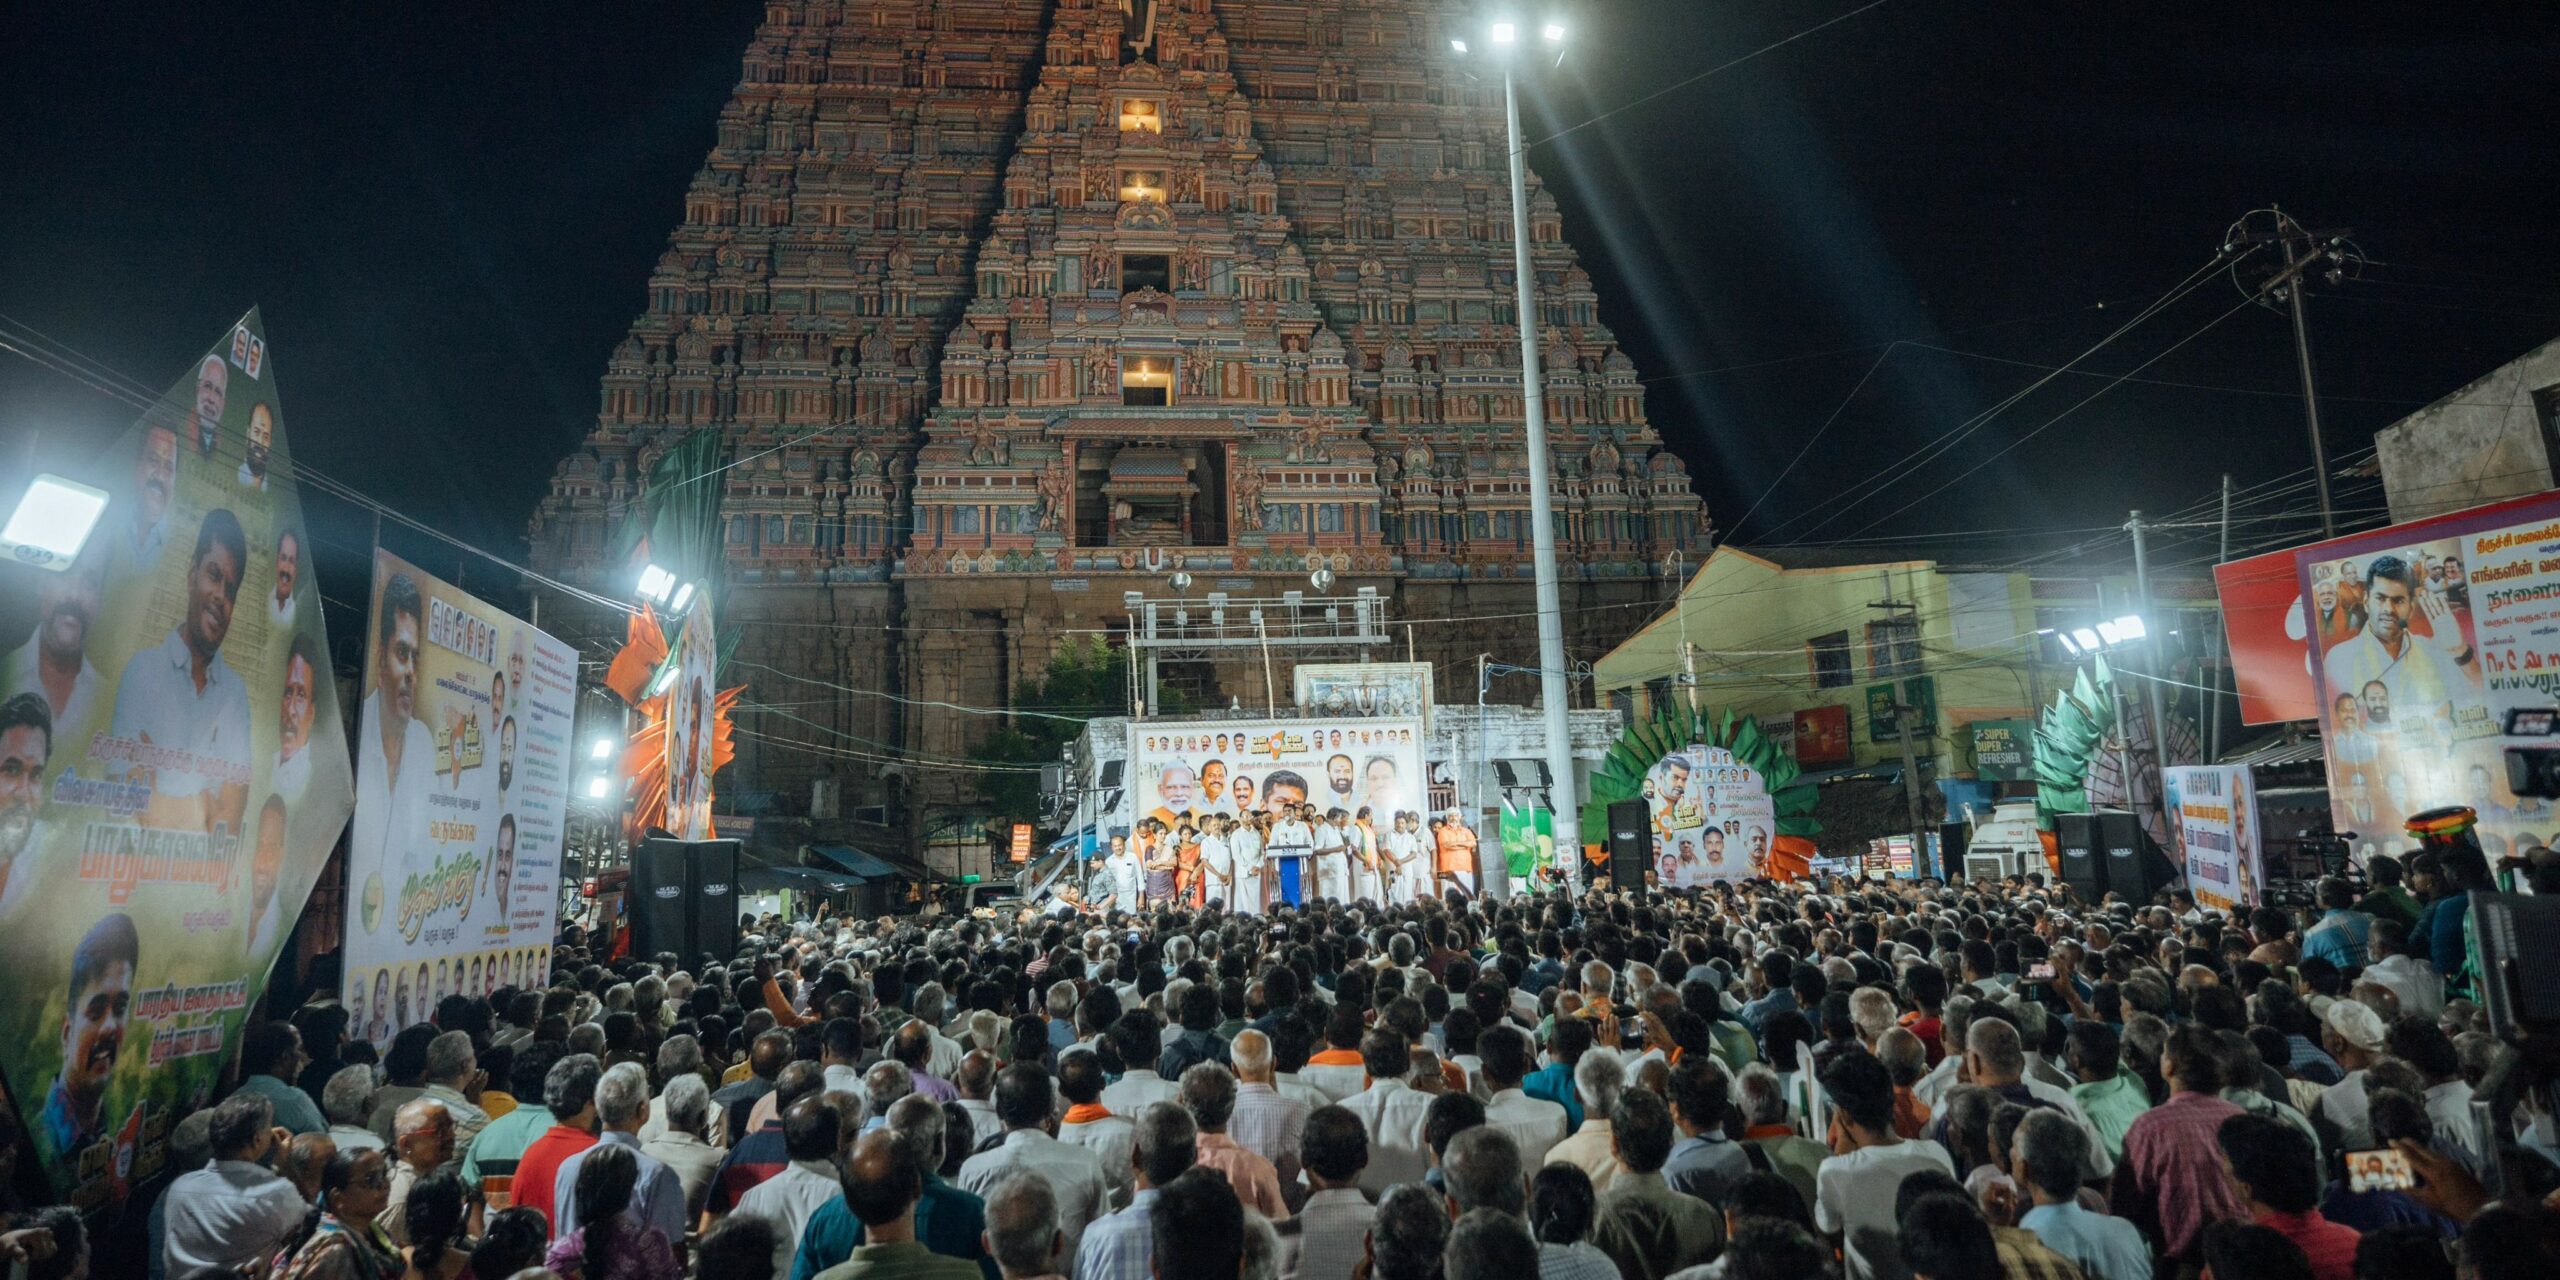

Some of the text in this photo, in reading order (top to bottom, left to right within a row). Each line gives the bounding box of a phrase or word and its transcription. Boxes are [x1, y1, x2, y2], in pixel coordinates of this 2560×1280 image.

[2470, 560, 2533, 584] எங்களின்
[1984, 728, 2009, 740] SUPER
[1975, 741, 2001, 752] DUPER
[1977, 752, 2021, 764] REFRESHER
